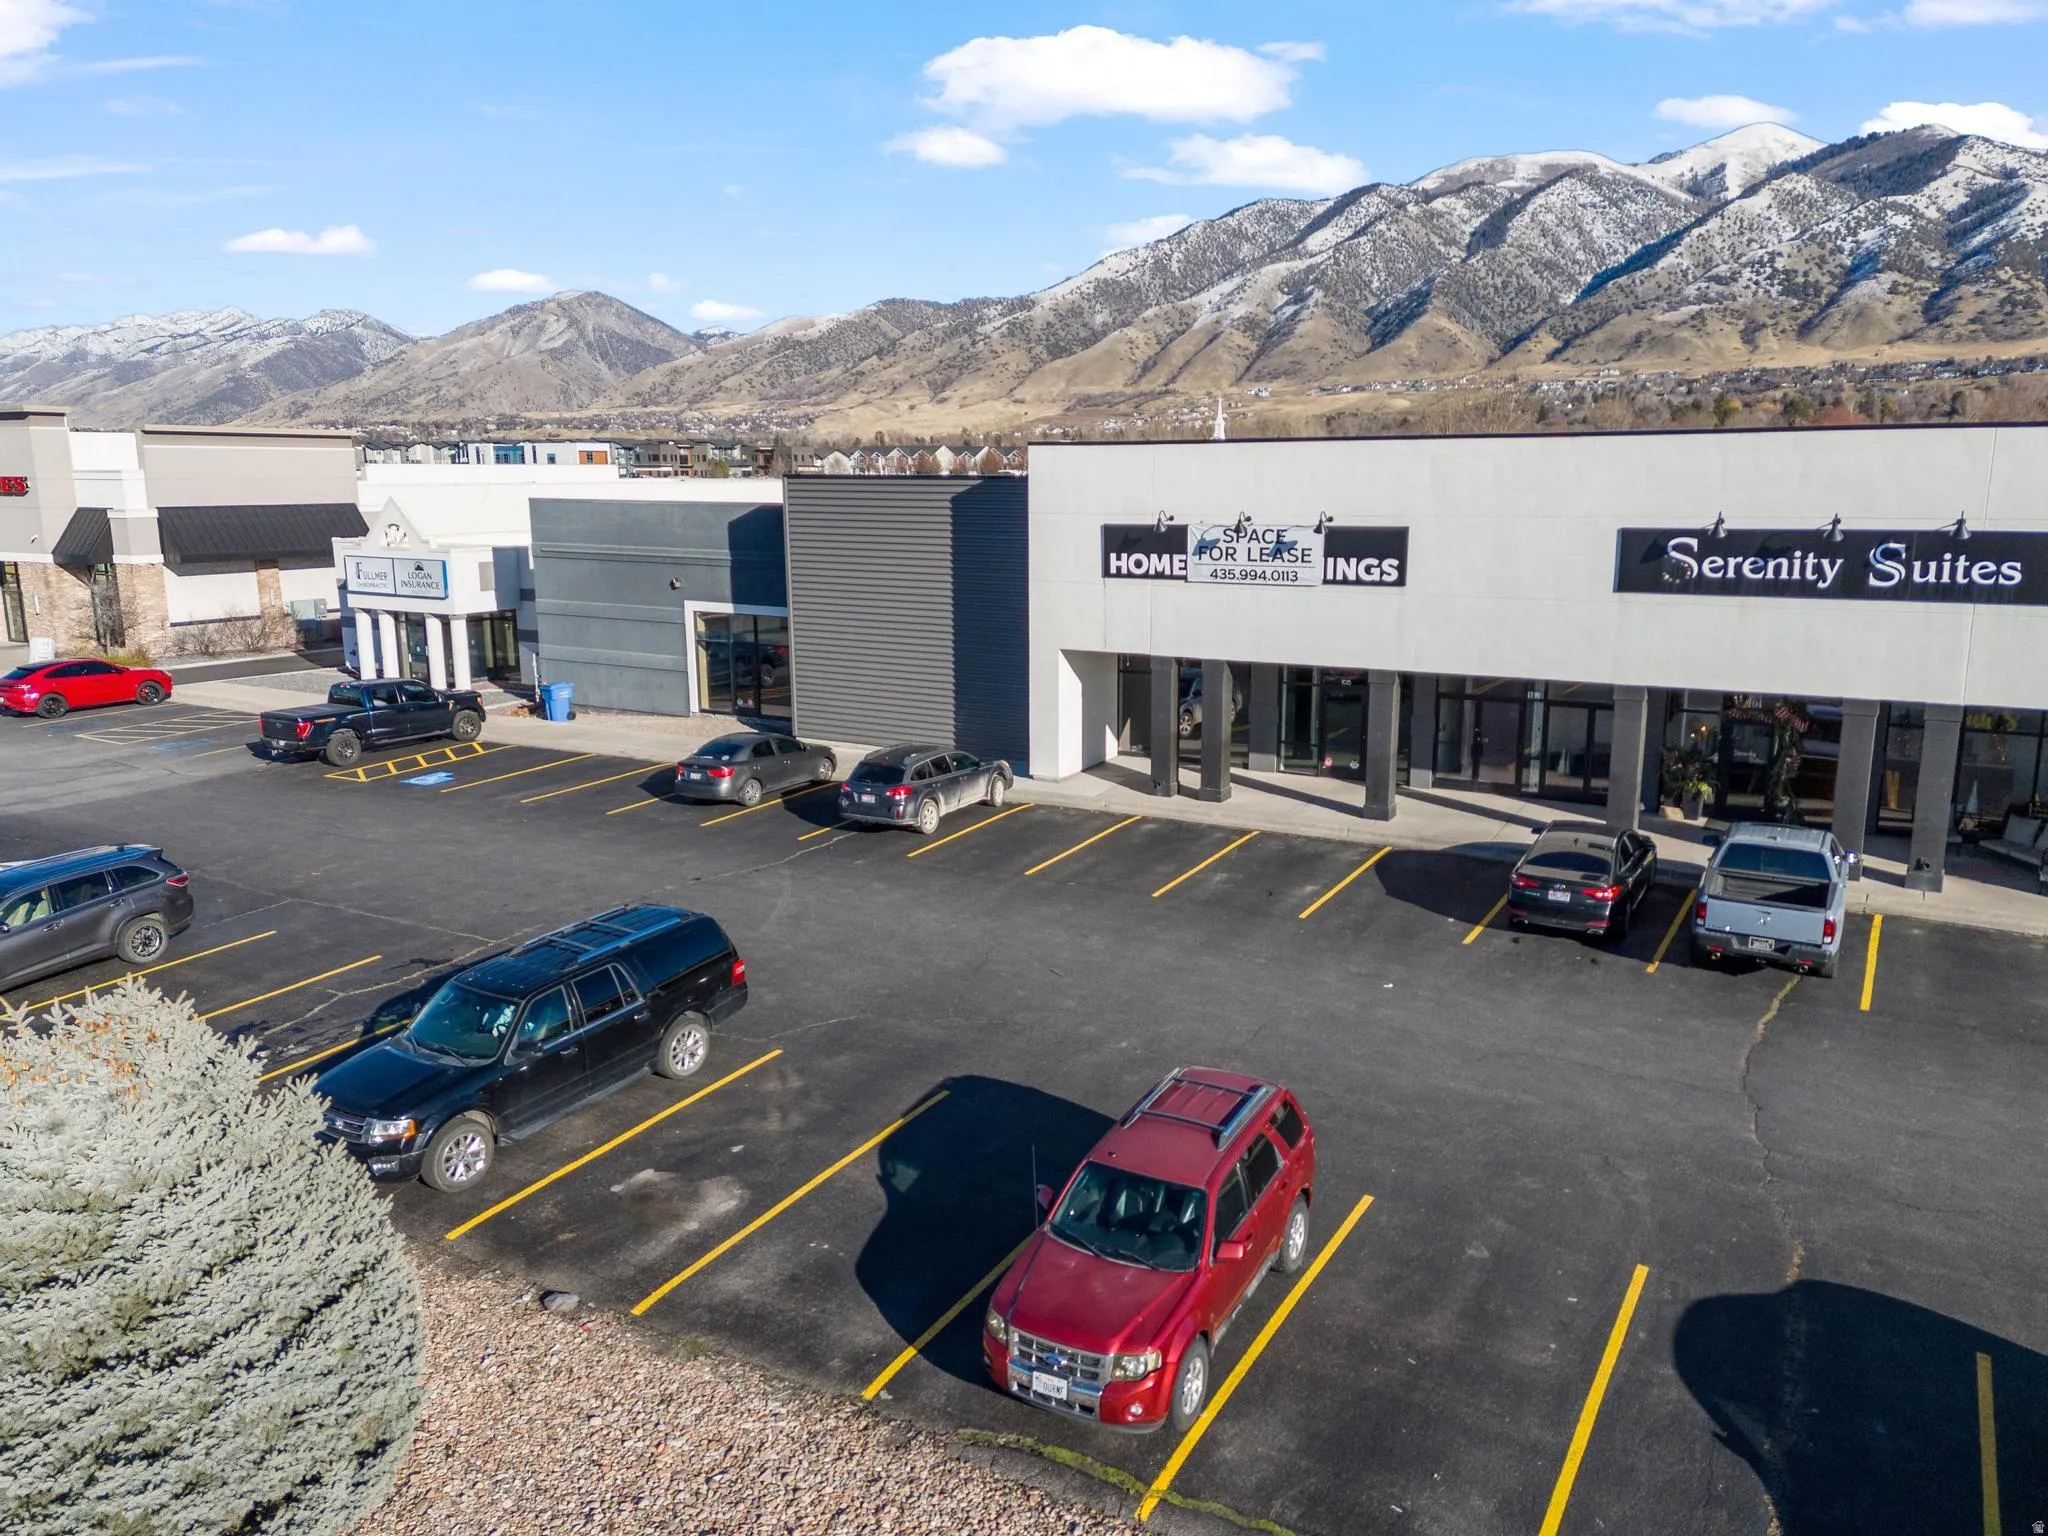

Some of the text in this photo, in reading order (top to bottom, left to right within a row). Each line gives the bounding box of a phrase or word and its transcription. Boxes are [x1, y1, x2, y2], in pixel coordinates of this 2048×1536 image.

[1222, 528, 1288, 545] SPACE
[1198, 546, 1313, 563] FOR LEASE
[1666, 536, 2023, 588] Serenity Suites
[355, 561, 388, 581] FULLMER
[407, 571, 433, 580] LOGAN
[1109, 552, 1400, 583] HOME INGS
[1209, 568, 1299, 583] 435.994.0113
[400, 580, 441, 590] INSURANCE
